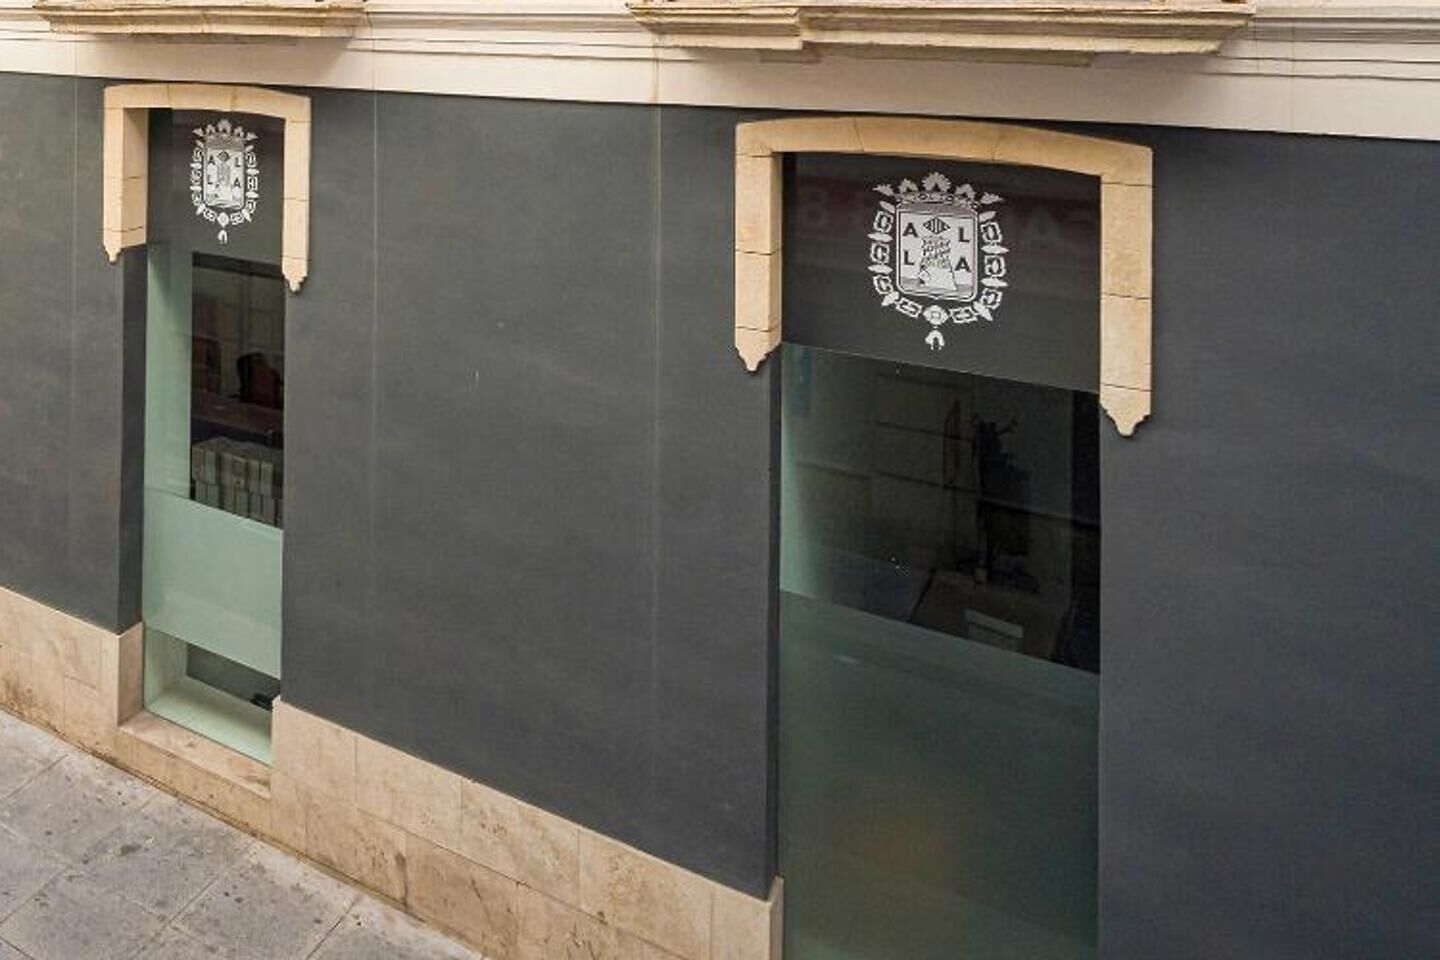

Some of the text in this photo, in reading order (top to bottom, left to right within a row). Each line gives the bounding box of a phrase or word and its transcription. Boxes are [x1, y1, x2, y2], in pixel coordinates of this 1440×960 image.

[903, 223, 971, 243] A L
[903, 250, 971, 272] L A
